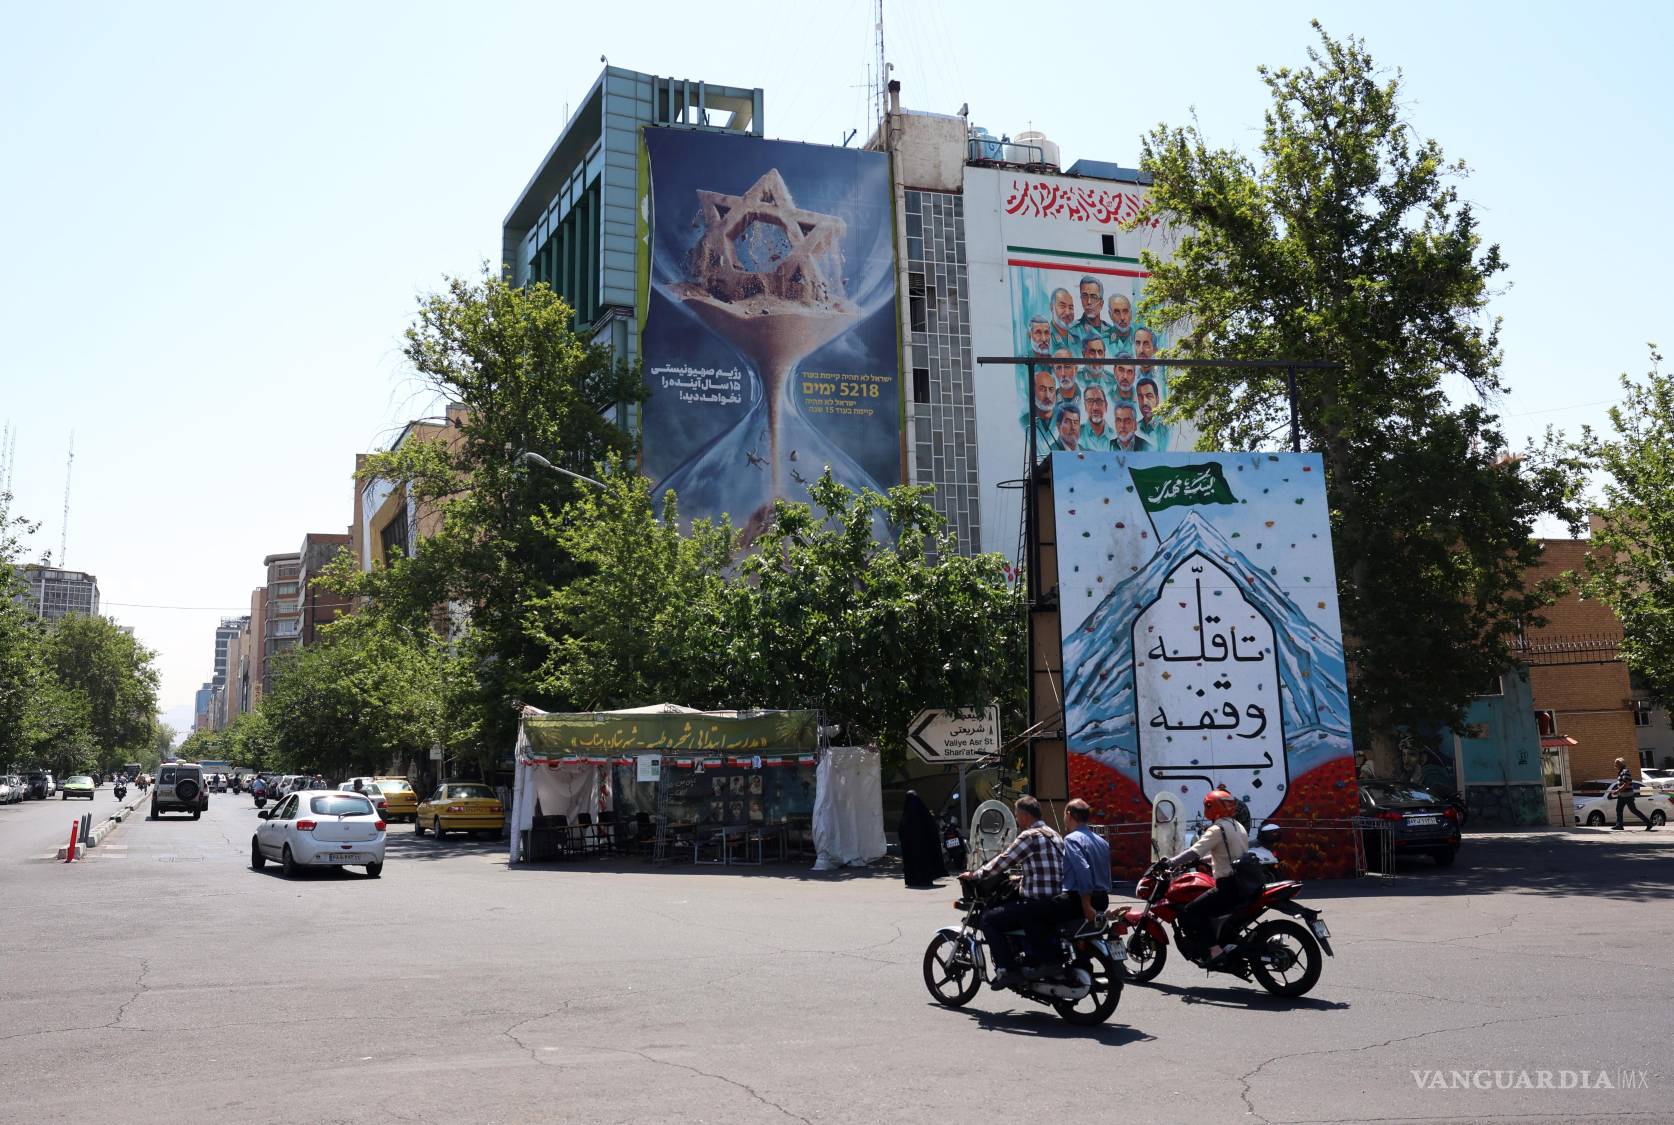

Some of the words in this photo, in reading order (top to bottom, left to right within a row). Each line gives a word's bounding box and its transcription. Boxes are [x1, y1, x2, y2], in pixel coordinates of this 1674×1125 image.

[650, 363, 715, 378] صهیونیستی
[715, 366, 741, 380] رژیم
[803, 381, 836, 395] ימים
[840, 382, 879, 397] 5218
[1230, 629, 1265, 662] تا
[950, 724, 984, 737] شریعتی
[944, 739, 967, 748] Valiye
[969, 738, 982, 746] Asr
